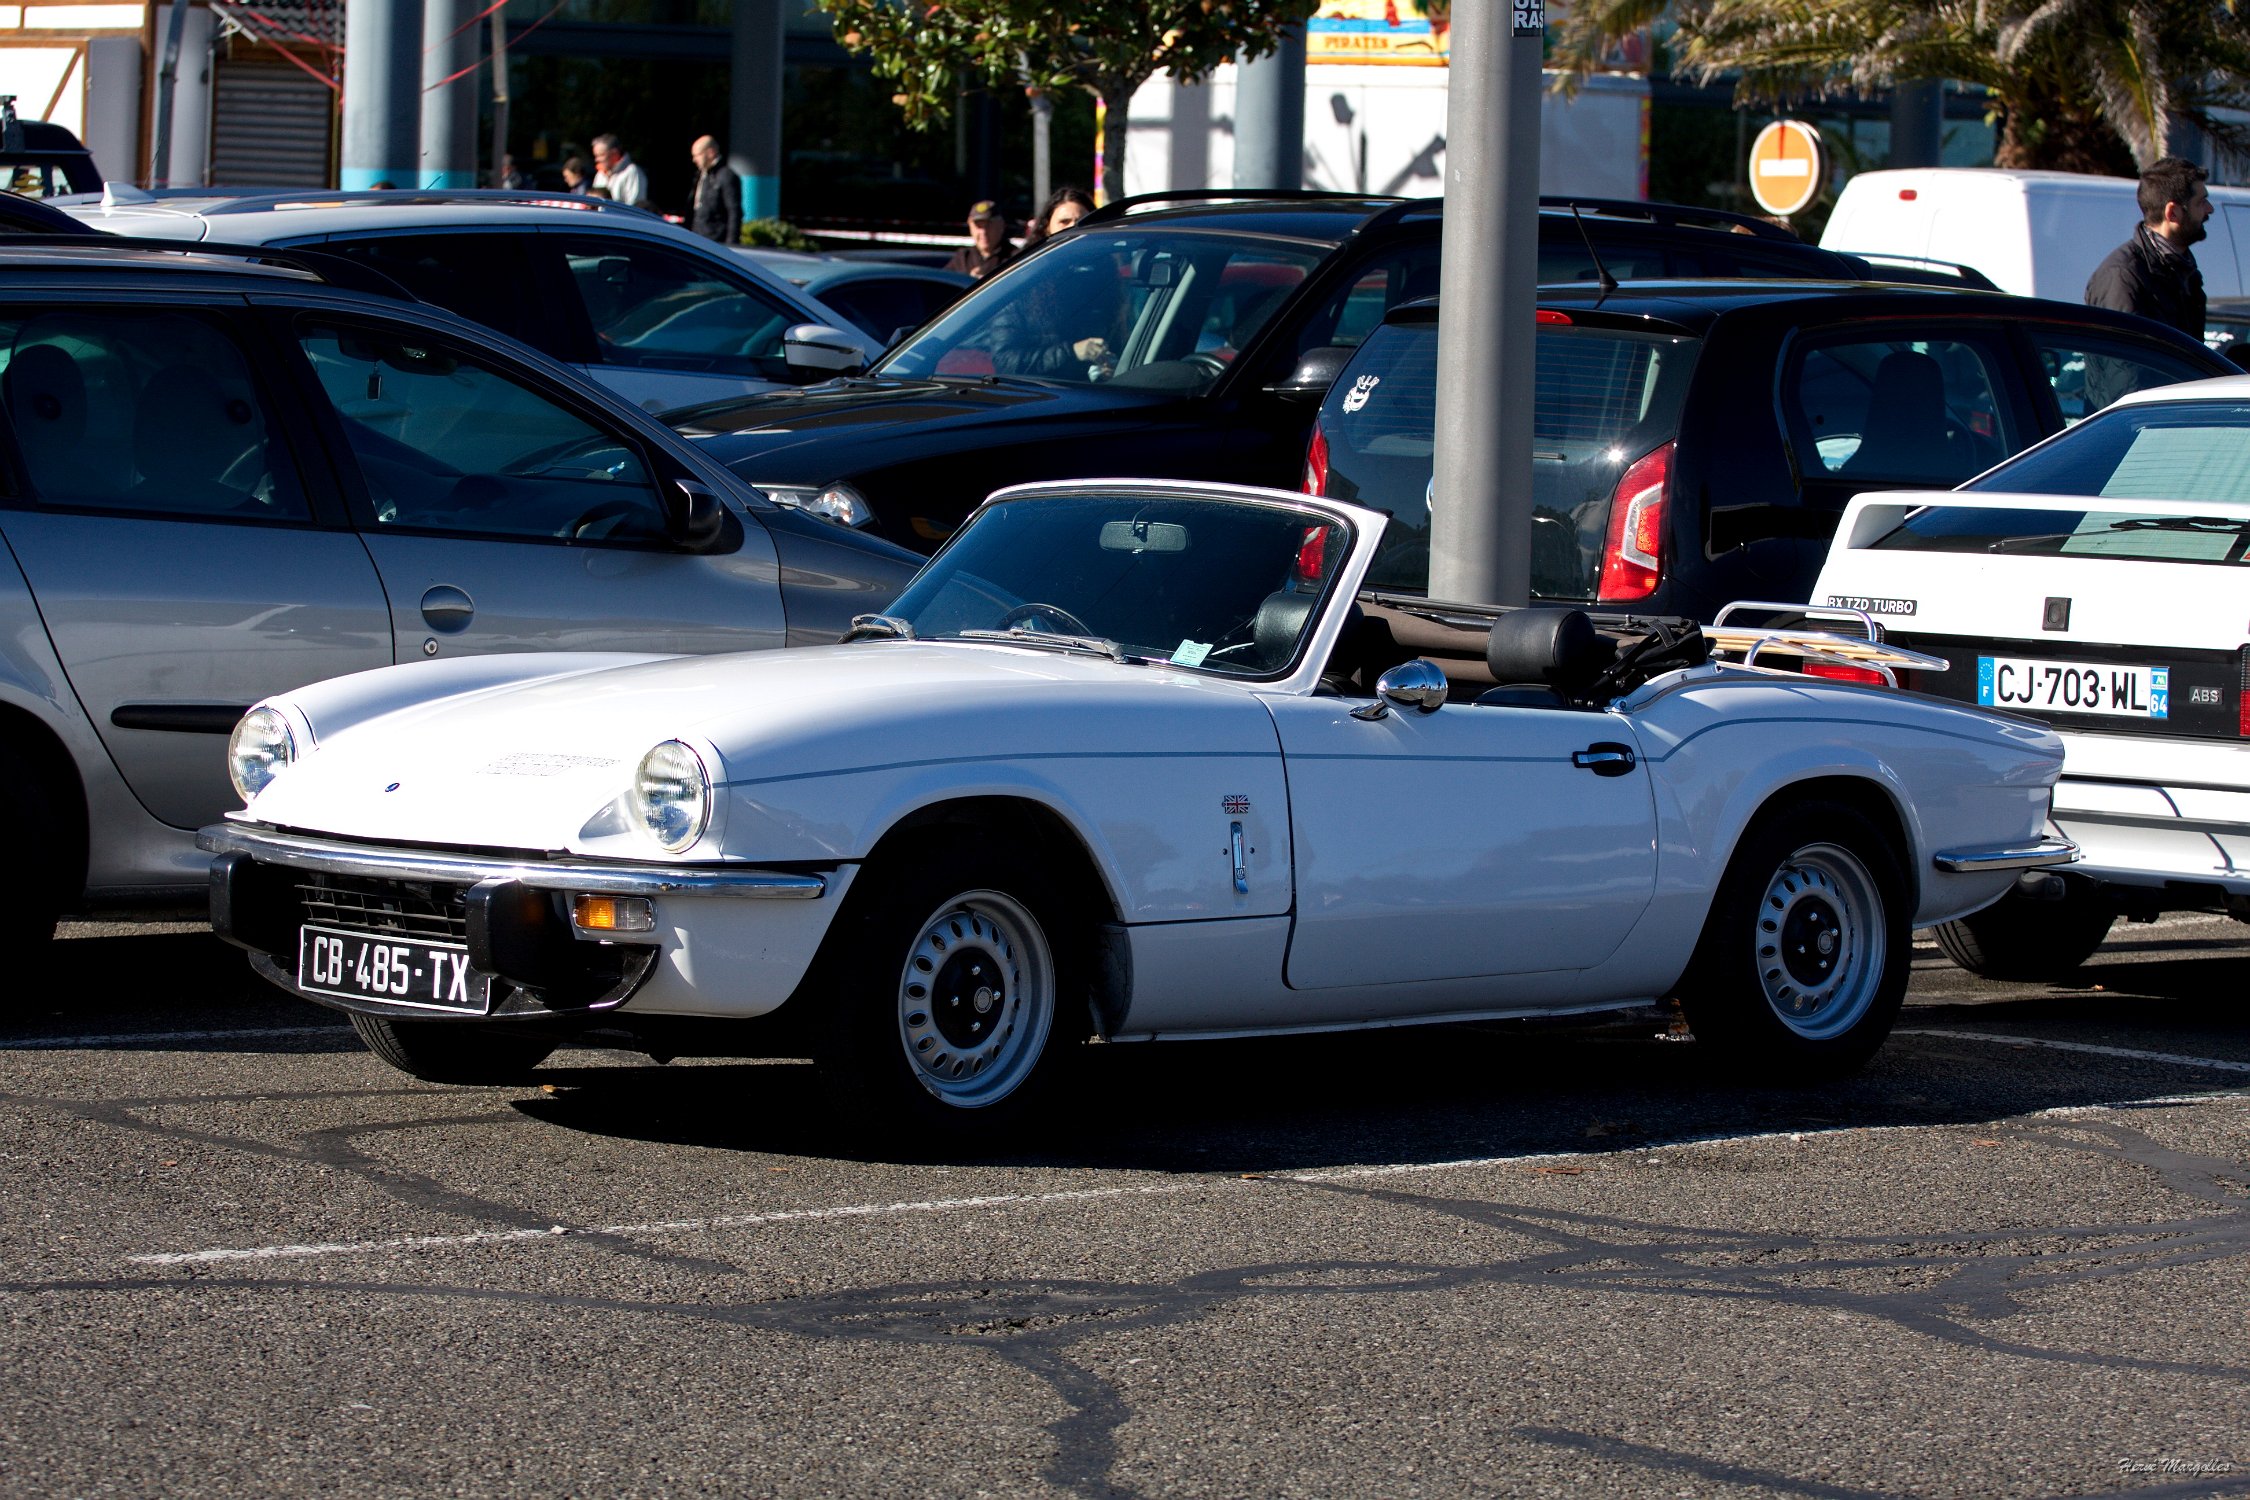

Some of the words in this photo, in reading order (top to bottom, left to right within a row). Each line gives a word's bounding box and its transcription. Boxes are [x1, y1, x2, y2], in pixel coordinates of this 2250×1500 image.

[1325, 36, 1388, 49] PIRATES
[1846, 598, 1869, 611] TZD
[1873, 599, 1914, 613] TURBO
[1982, 685, 1990, 697] F
[2191, 689, 2220, 703] ABS
[2150, 693, 2168, 713] 64
